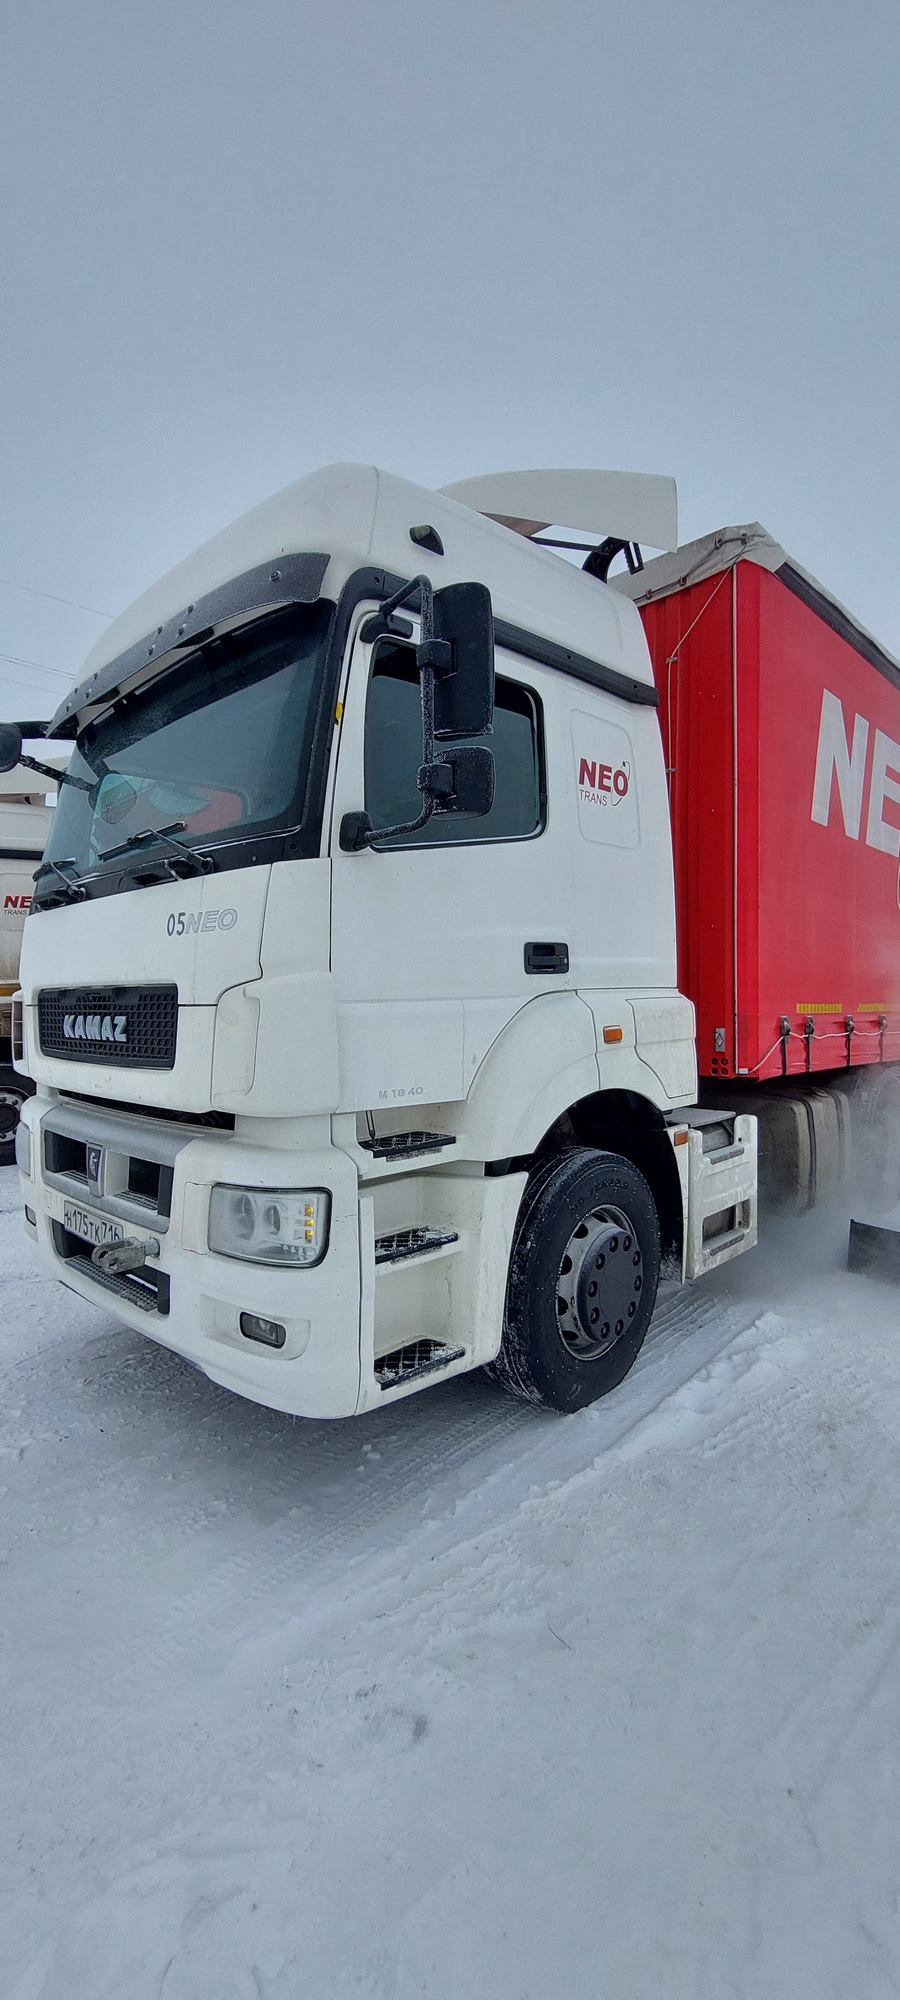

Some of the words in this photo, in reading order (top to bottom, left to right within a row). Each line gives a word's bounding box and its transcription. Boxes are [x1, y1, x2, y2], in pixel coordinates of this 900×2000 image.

[579, 757, 629, 797] NEO
[579, 789, 608, 807] TRANS
[63, 1014, 128, 1042] KAMAZ
